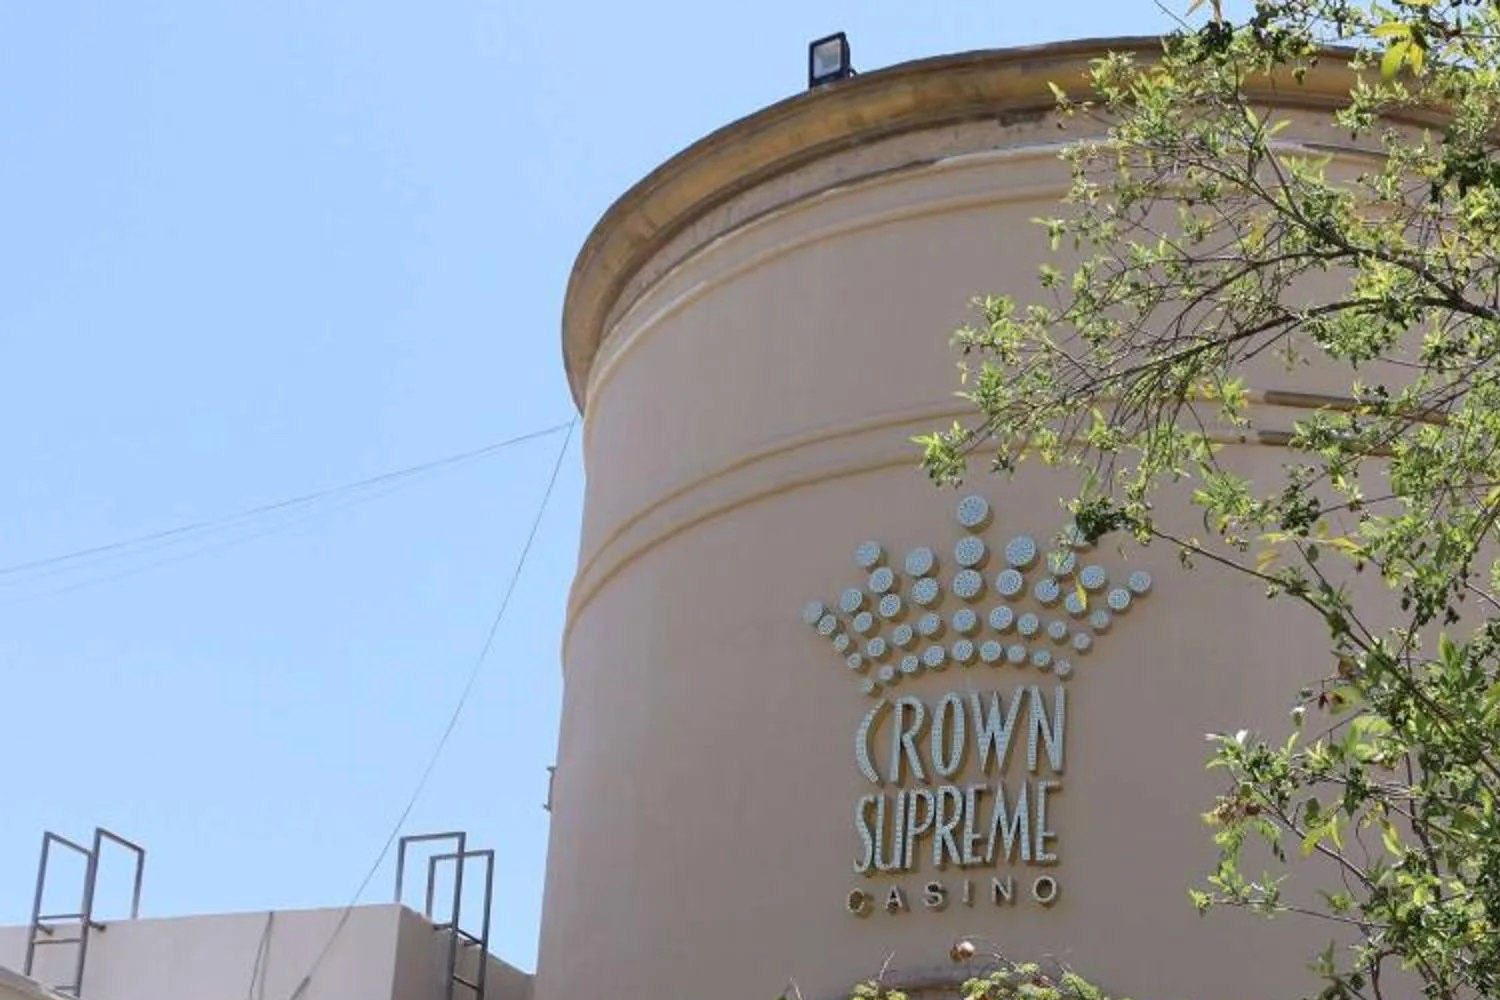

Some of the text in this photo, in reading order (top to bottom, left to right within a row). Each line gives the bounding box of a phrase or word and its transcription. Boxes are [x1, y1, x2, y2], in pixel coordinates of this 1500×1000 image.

[855, 685, 1066, 783] CROWN
[853, 779, 1061, 873] SUPREME
[847, 876, 1057, 912] CASINO
